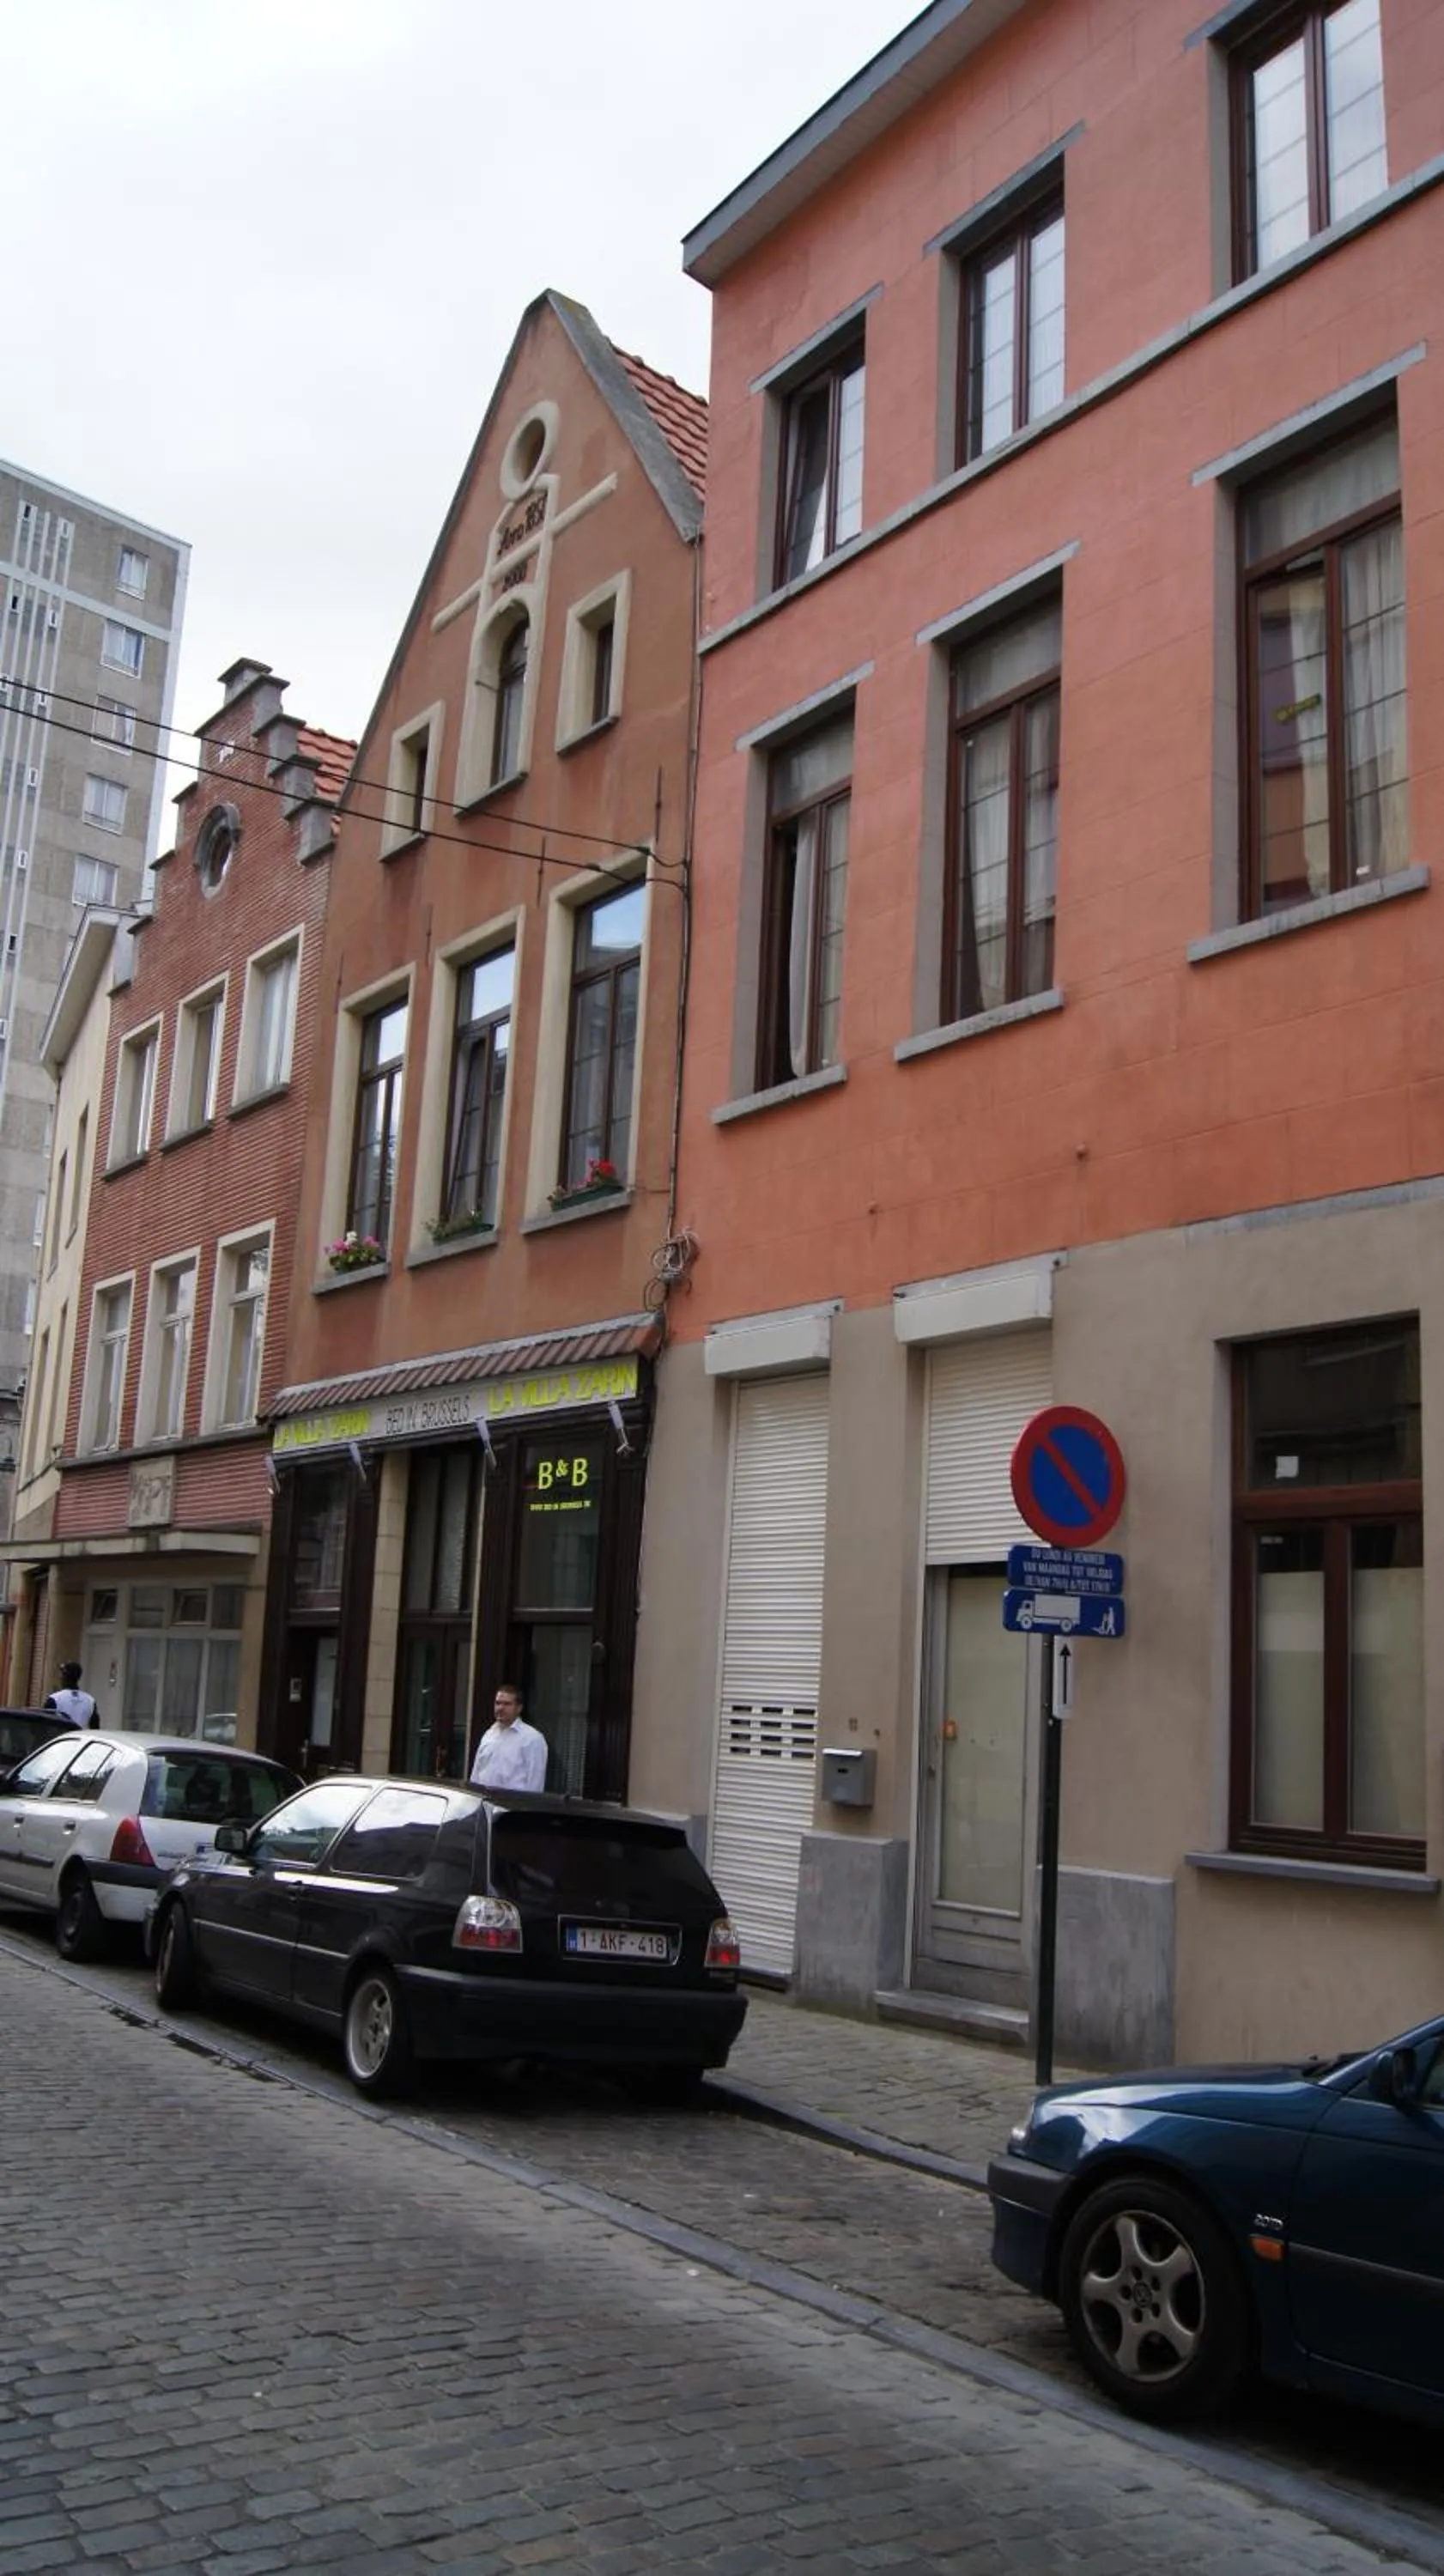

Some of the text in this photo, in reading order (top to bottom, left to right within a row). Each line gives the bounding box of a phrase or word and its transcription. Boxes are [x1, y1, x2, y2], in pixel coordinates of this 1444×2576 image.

[522, 1373, 573, 1406] VILLA
[576, 1362, 635, 1399] ZARIN
[385, 1407, 404, 1435] BED
[422, 1394, 470, 1428] BRUSSELS
[537, 1458, 588, 1490] B&B
